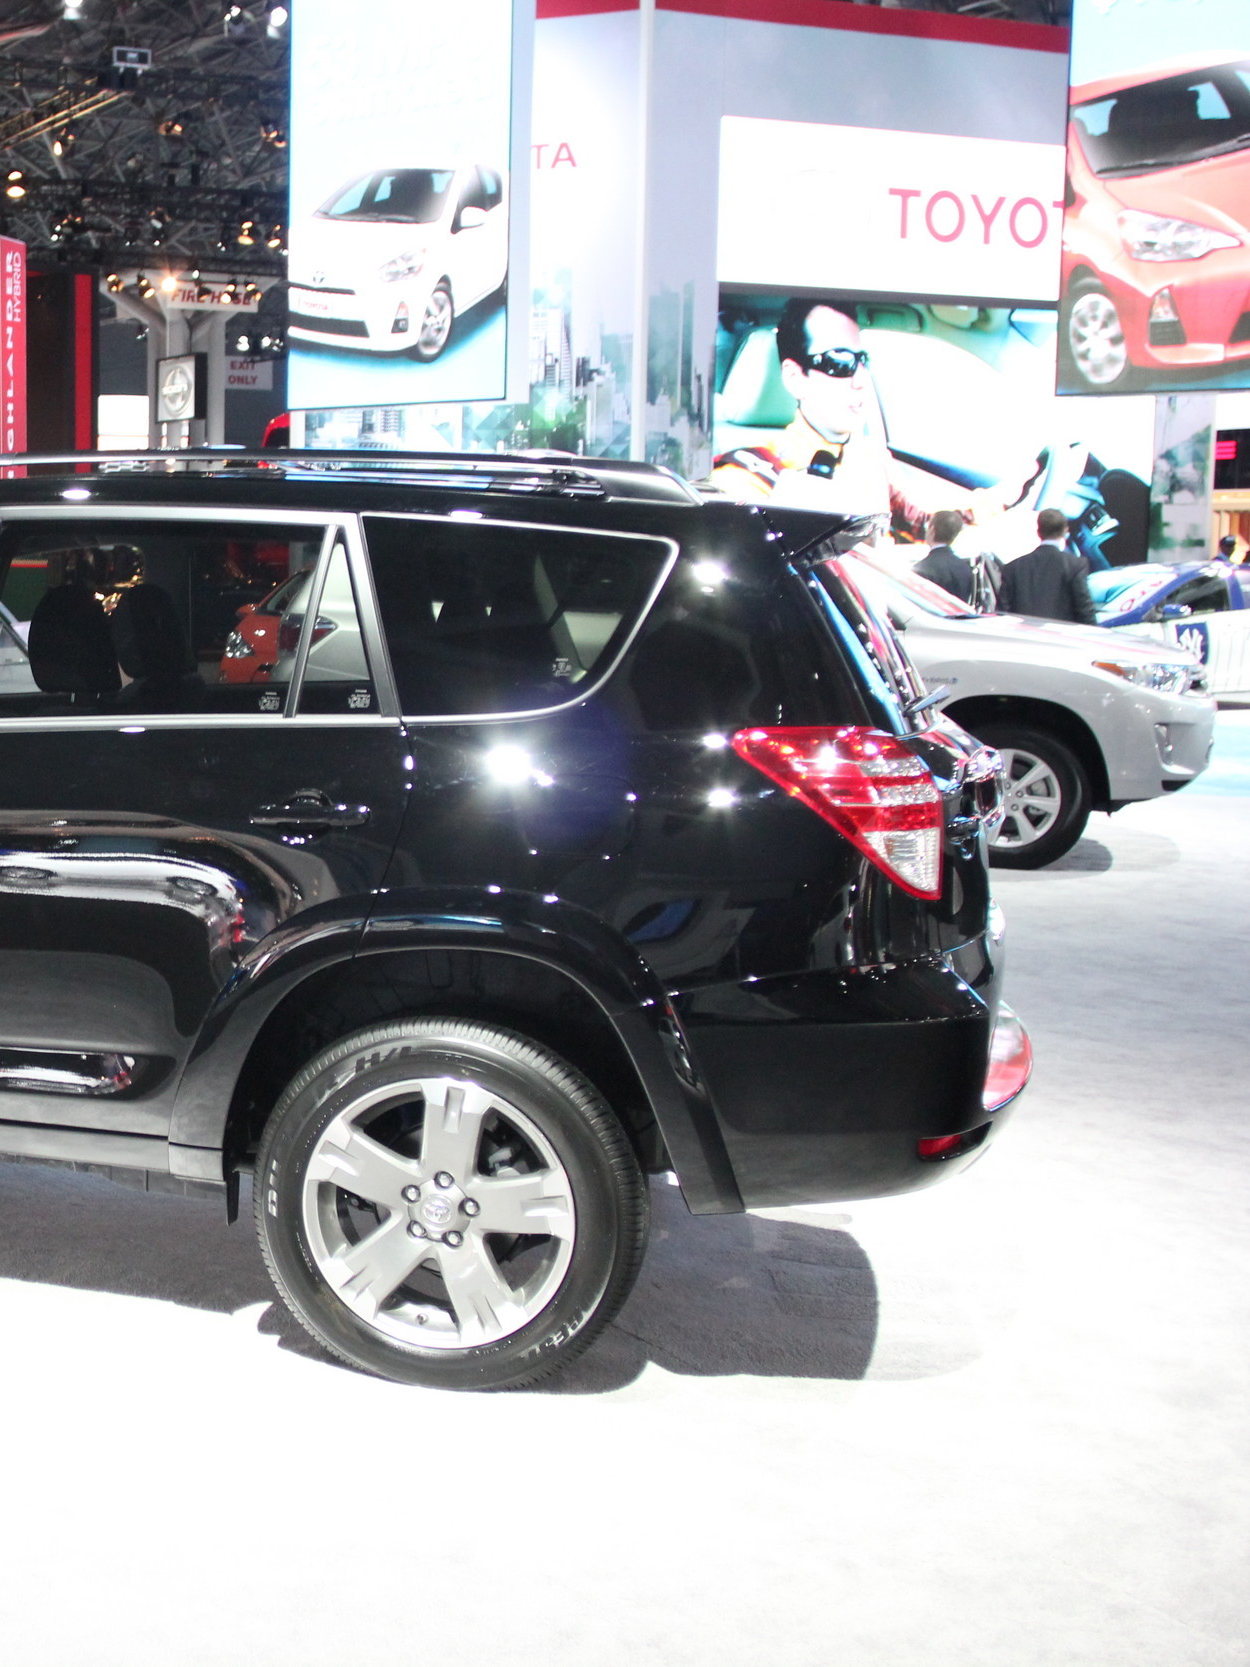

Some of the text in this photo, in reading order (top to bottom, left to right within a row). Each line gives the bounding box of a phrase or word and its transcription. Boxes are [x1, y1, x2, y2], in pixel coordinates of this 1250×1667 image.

[889, 188, 1064, 249] TOYO
[13, 252, 21, 322] HYBRID
[228, 374, 258, 385] ONLY
